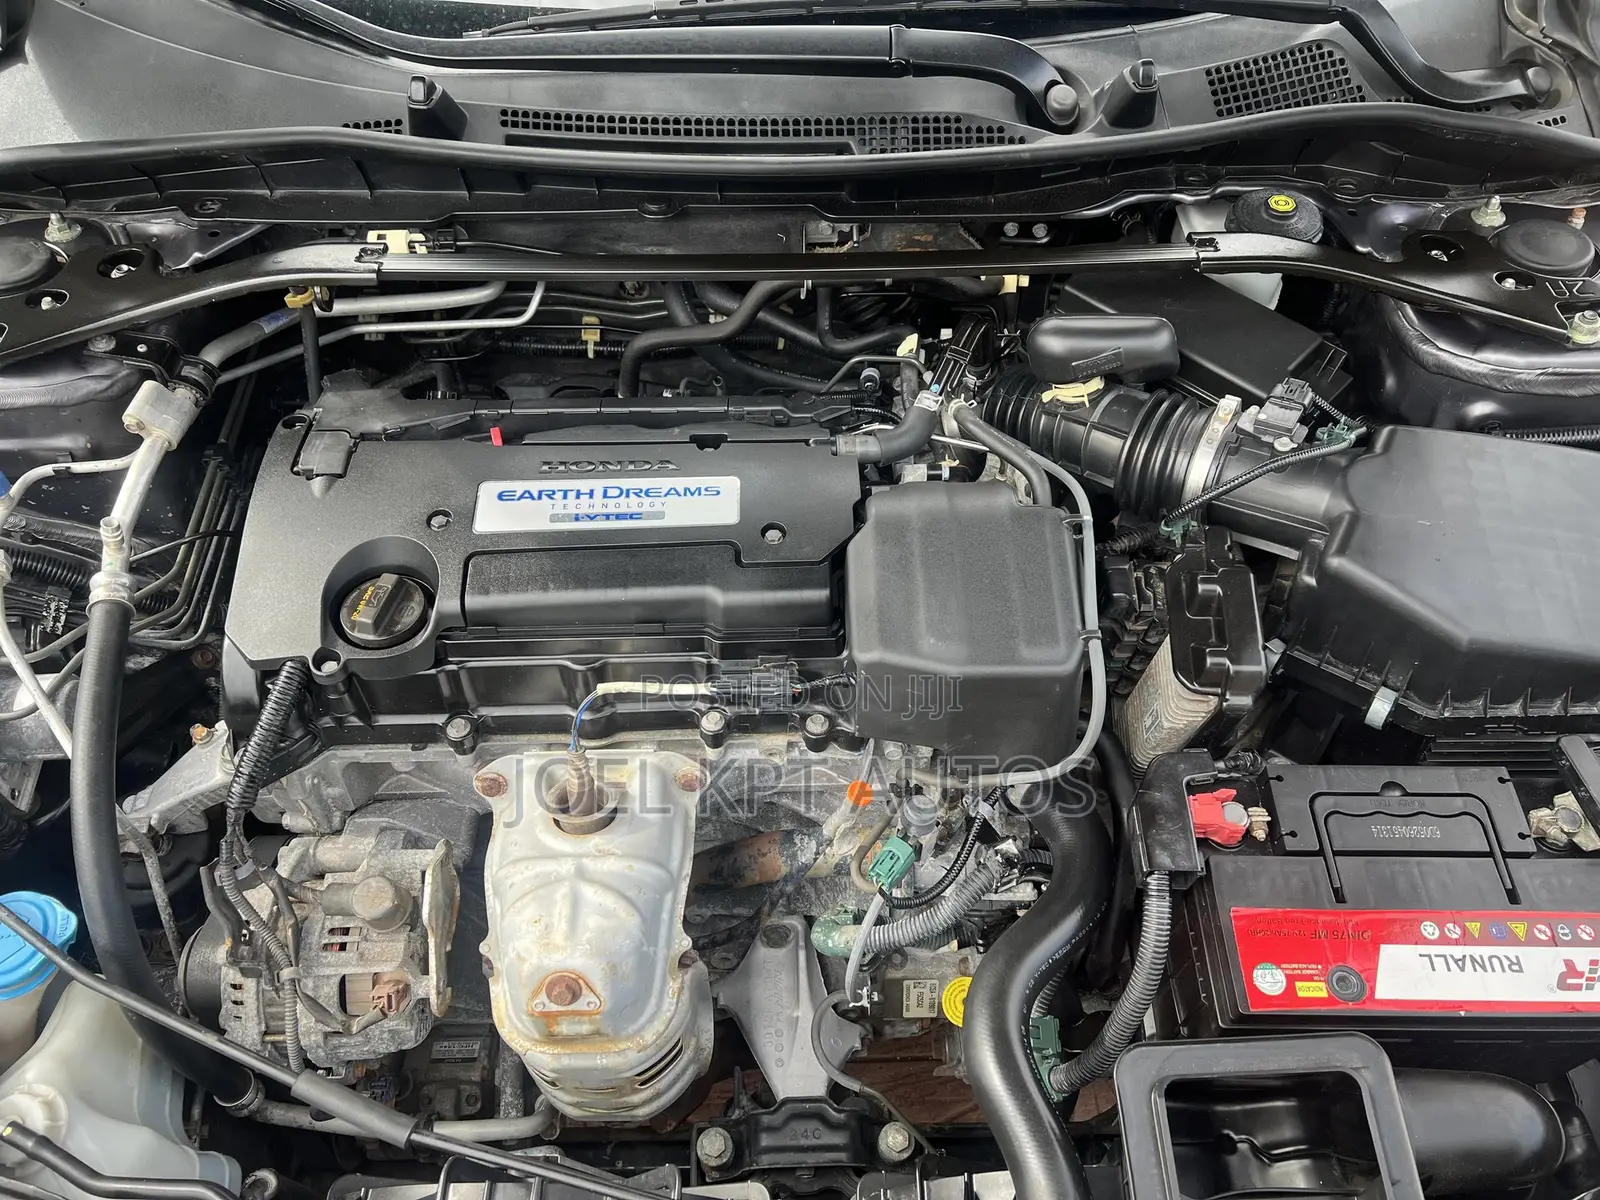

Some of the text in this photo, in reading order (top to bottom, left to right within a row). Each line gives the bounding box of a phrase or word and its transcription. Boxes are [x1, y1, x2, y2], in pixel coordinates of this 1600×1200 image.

[538, 459, 681, 474] HONDA
[497, 485, 721, 501] EARTH DREAMS
[551, 501, 667, 511] TECHNOLOGY
[574, 513, 643, 521] i-VTEC
[1419, 953, 1525, 974] RUNALL
[1297, 983, 1324, 993] INDICATOR
